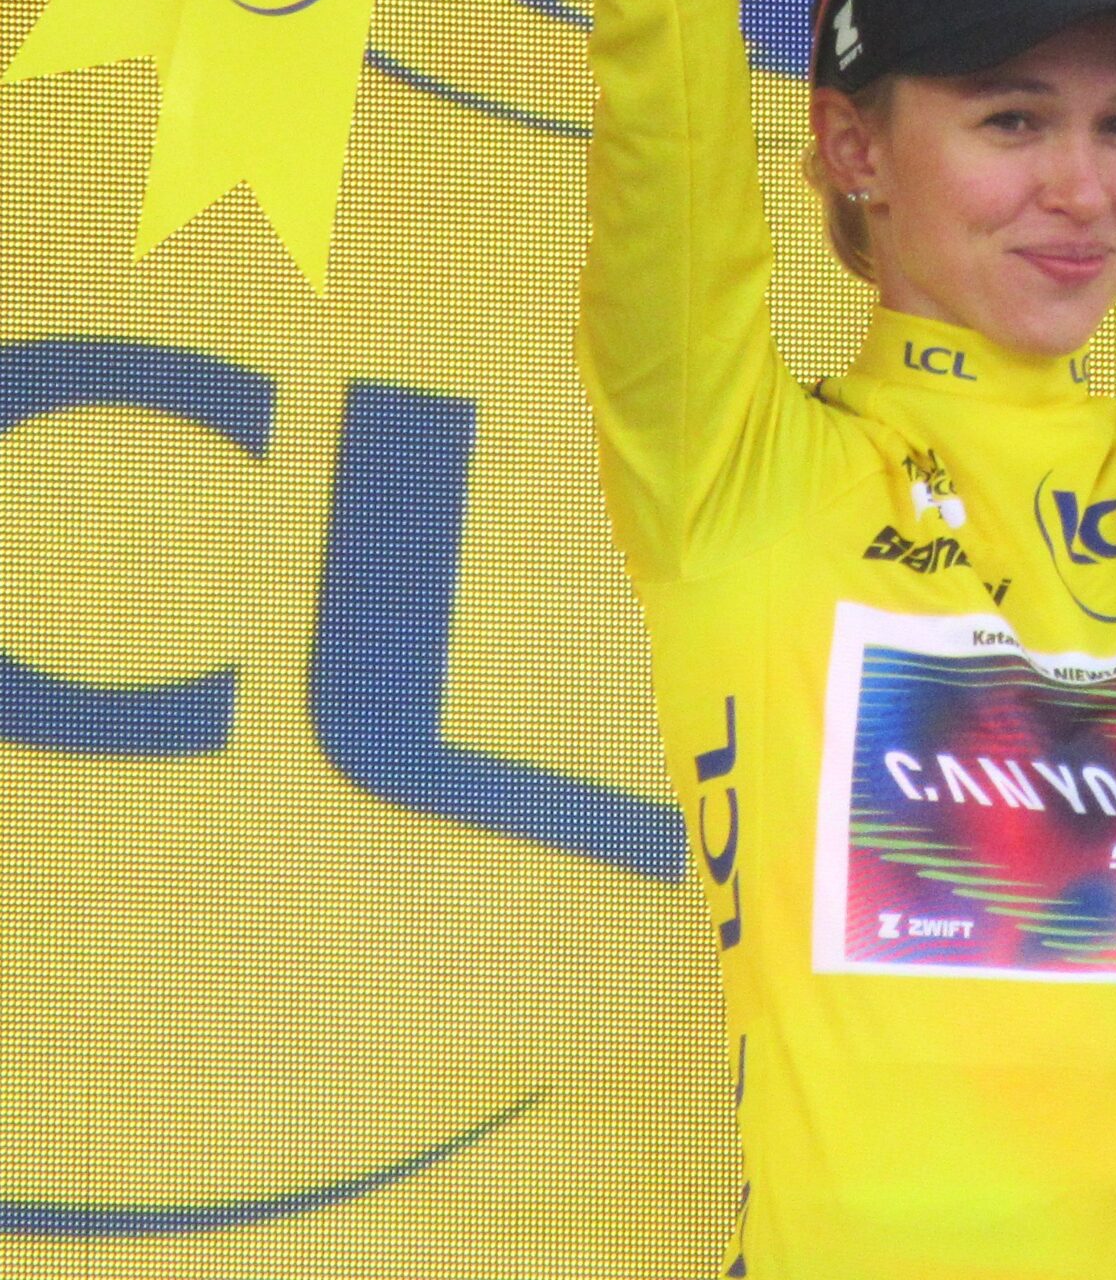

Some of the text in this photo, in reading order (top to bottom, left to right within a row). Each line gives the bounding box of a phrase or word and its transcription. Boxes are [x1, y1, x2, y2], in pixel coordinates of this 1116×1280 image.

[903, 340, 977, 382] LCL
[694, 695, 741, 953] LCL
[908, 918, 975, 940] ZWIFT
